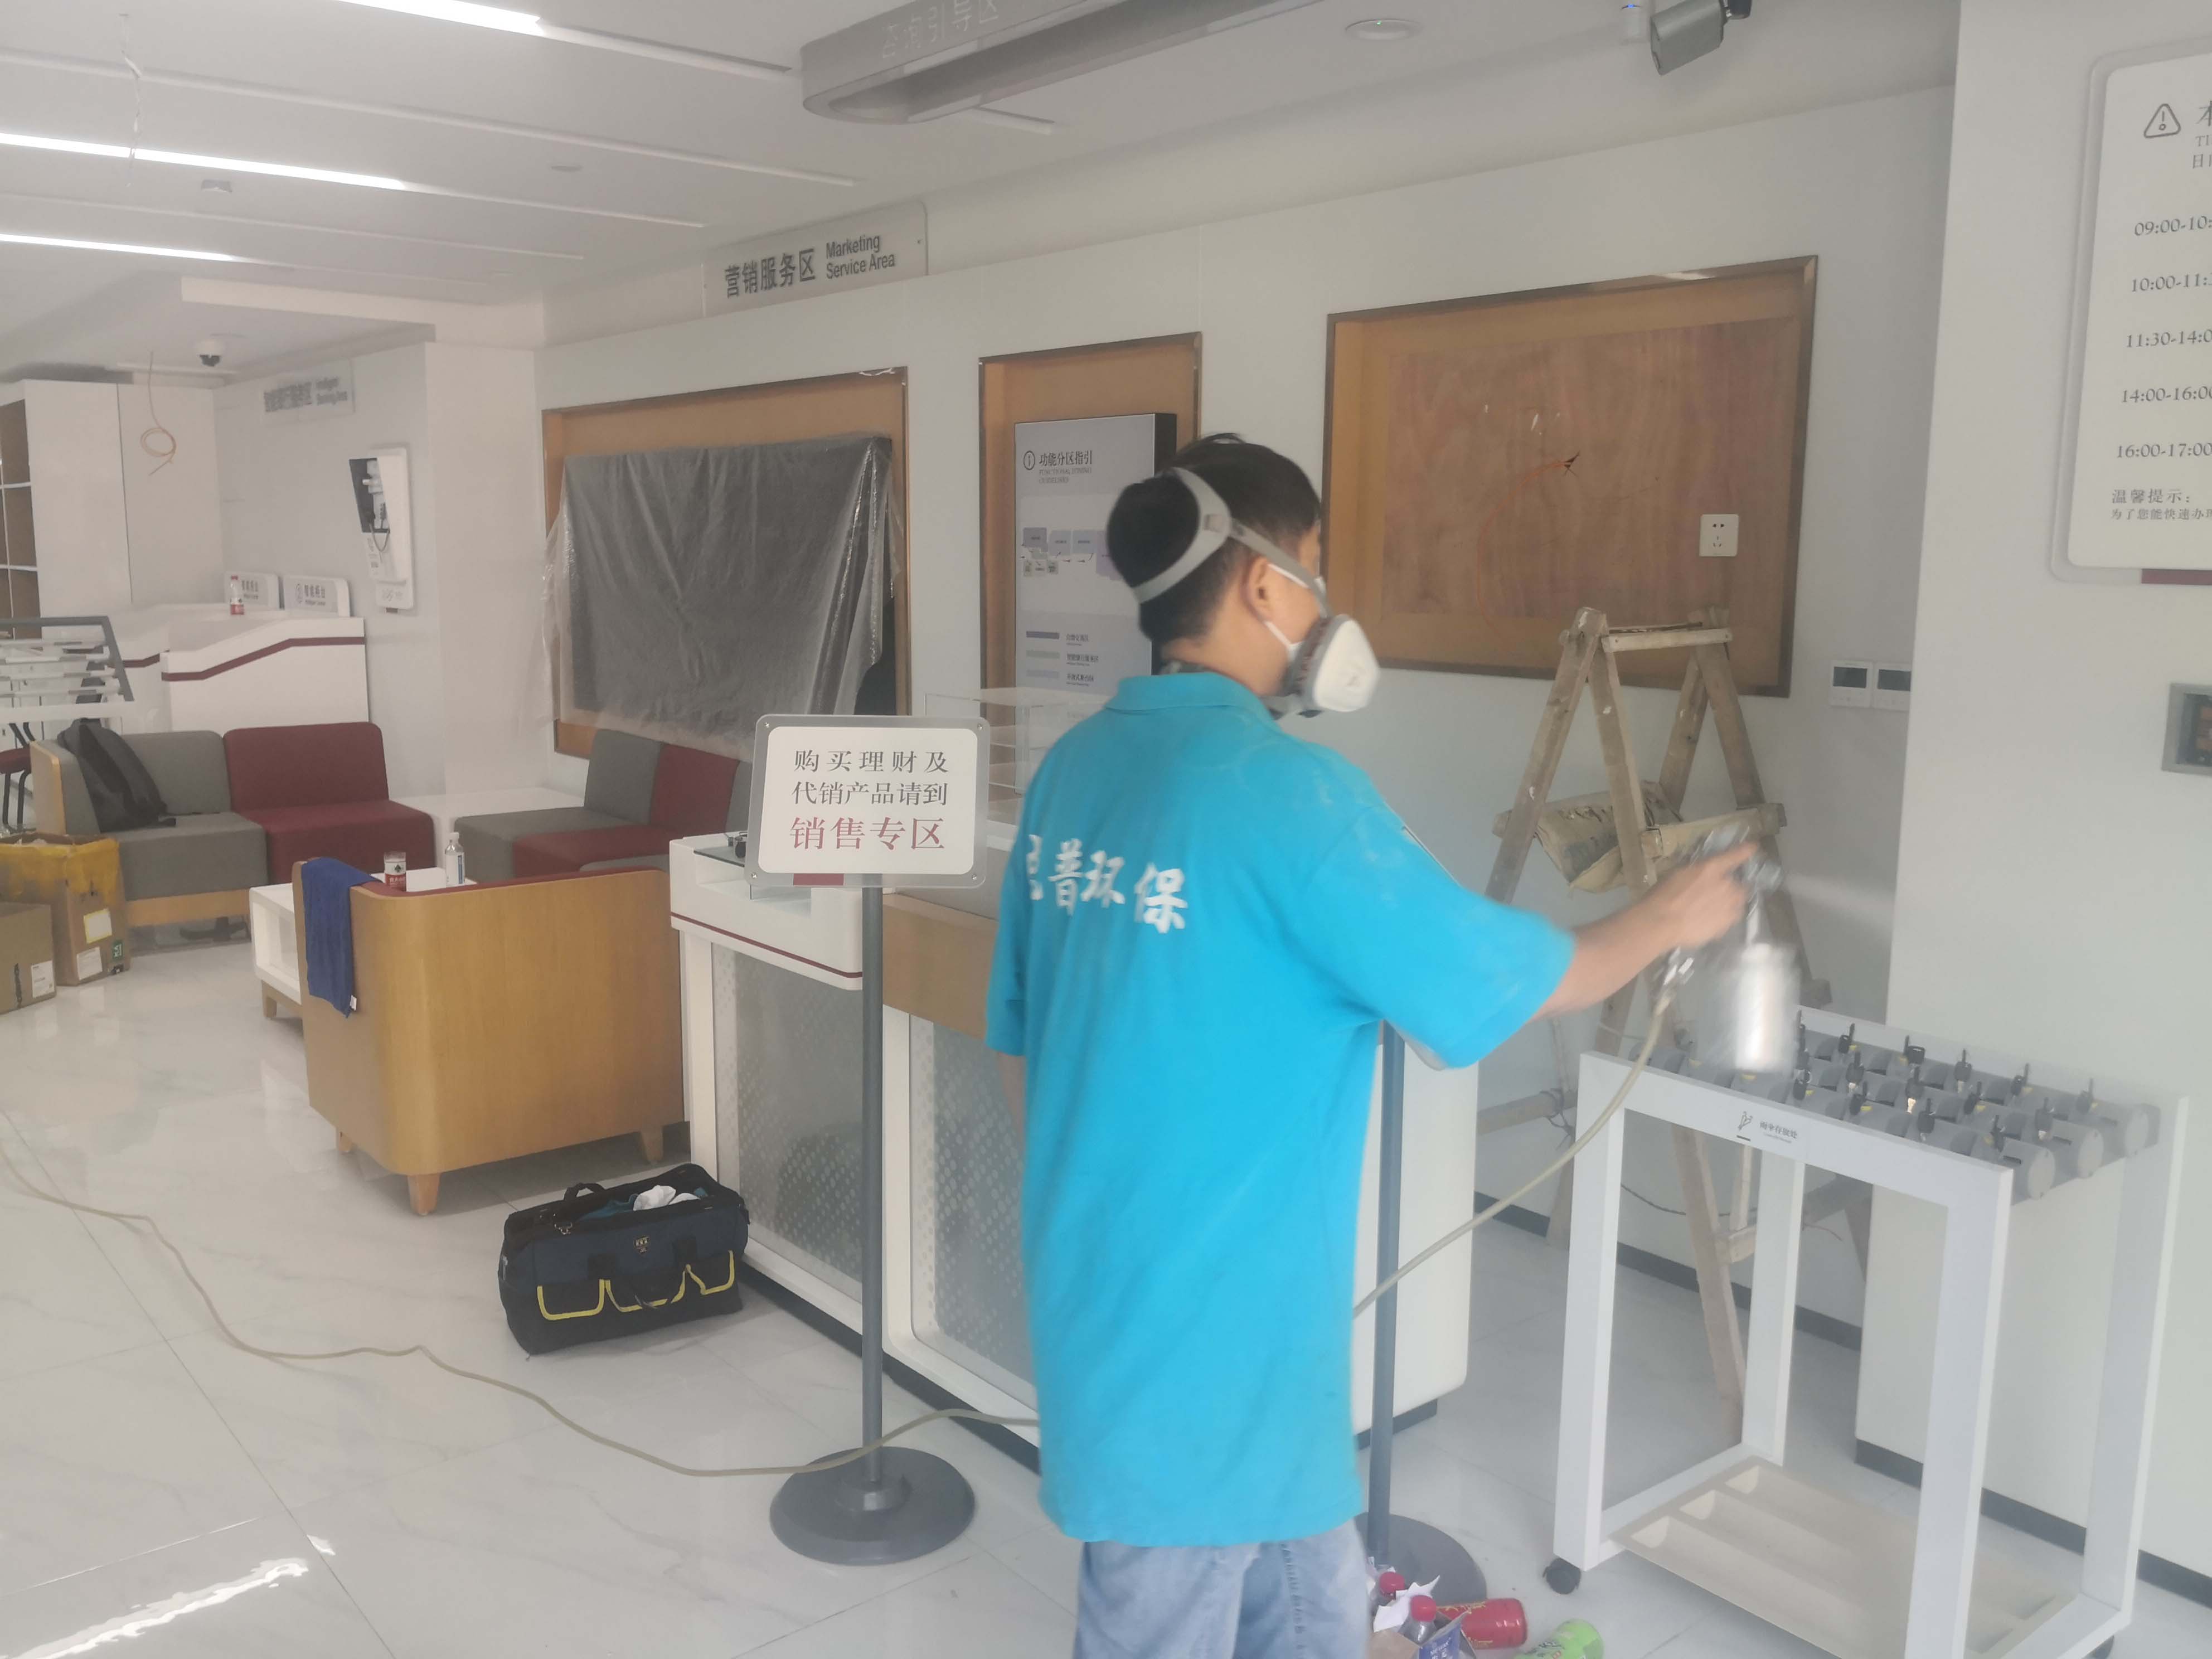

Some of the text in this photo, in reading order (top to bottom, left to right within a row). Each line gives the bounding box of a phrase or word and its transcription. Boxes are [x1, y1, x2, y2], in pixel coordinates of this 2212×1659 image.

[2195, 134, 2212, 147] TI
[826, 235, 880, 259] Marketing
[724, 248, 816, 299] 营销服务区
[826, 253, 895, 279] Service Area
[1039, 450, 1093, 466] 功能分区指引
[2117, 443, 2212, 458] 16:00-17:00
[794, 750, 949, 773] 购买理财及
[792, 781, 948, 806] 代销产品请到
[789, 816, 945, 851] 销售专区
